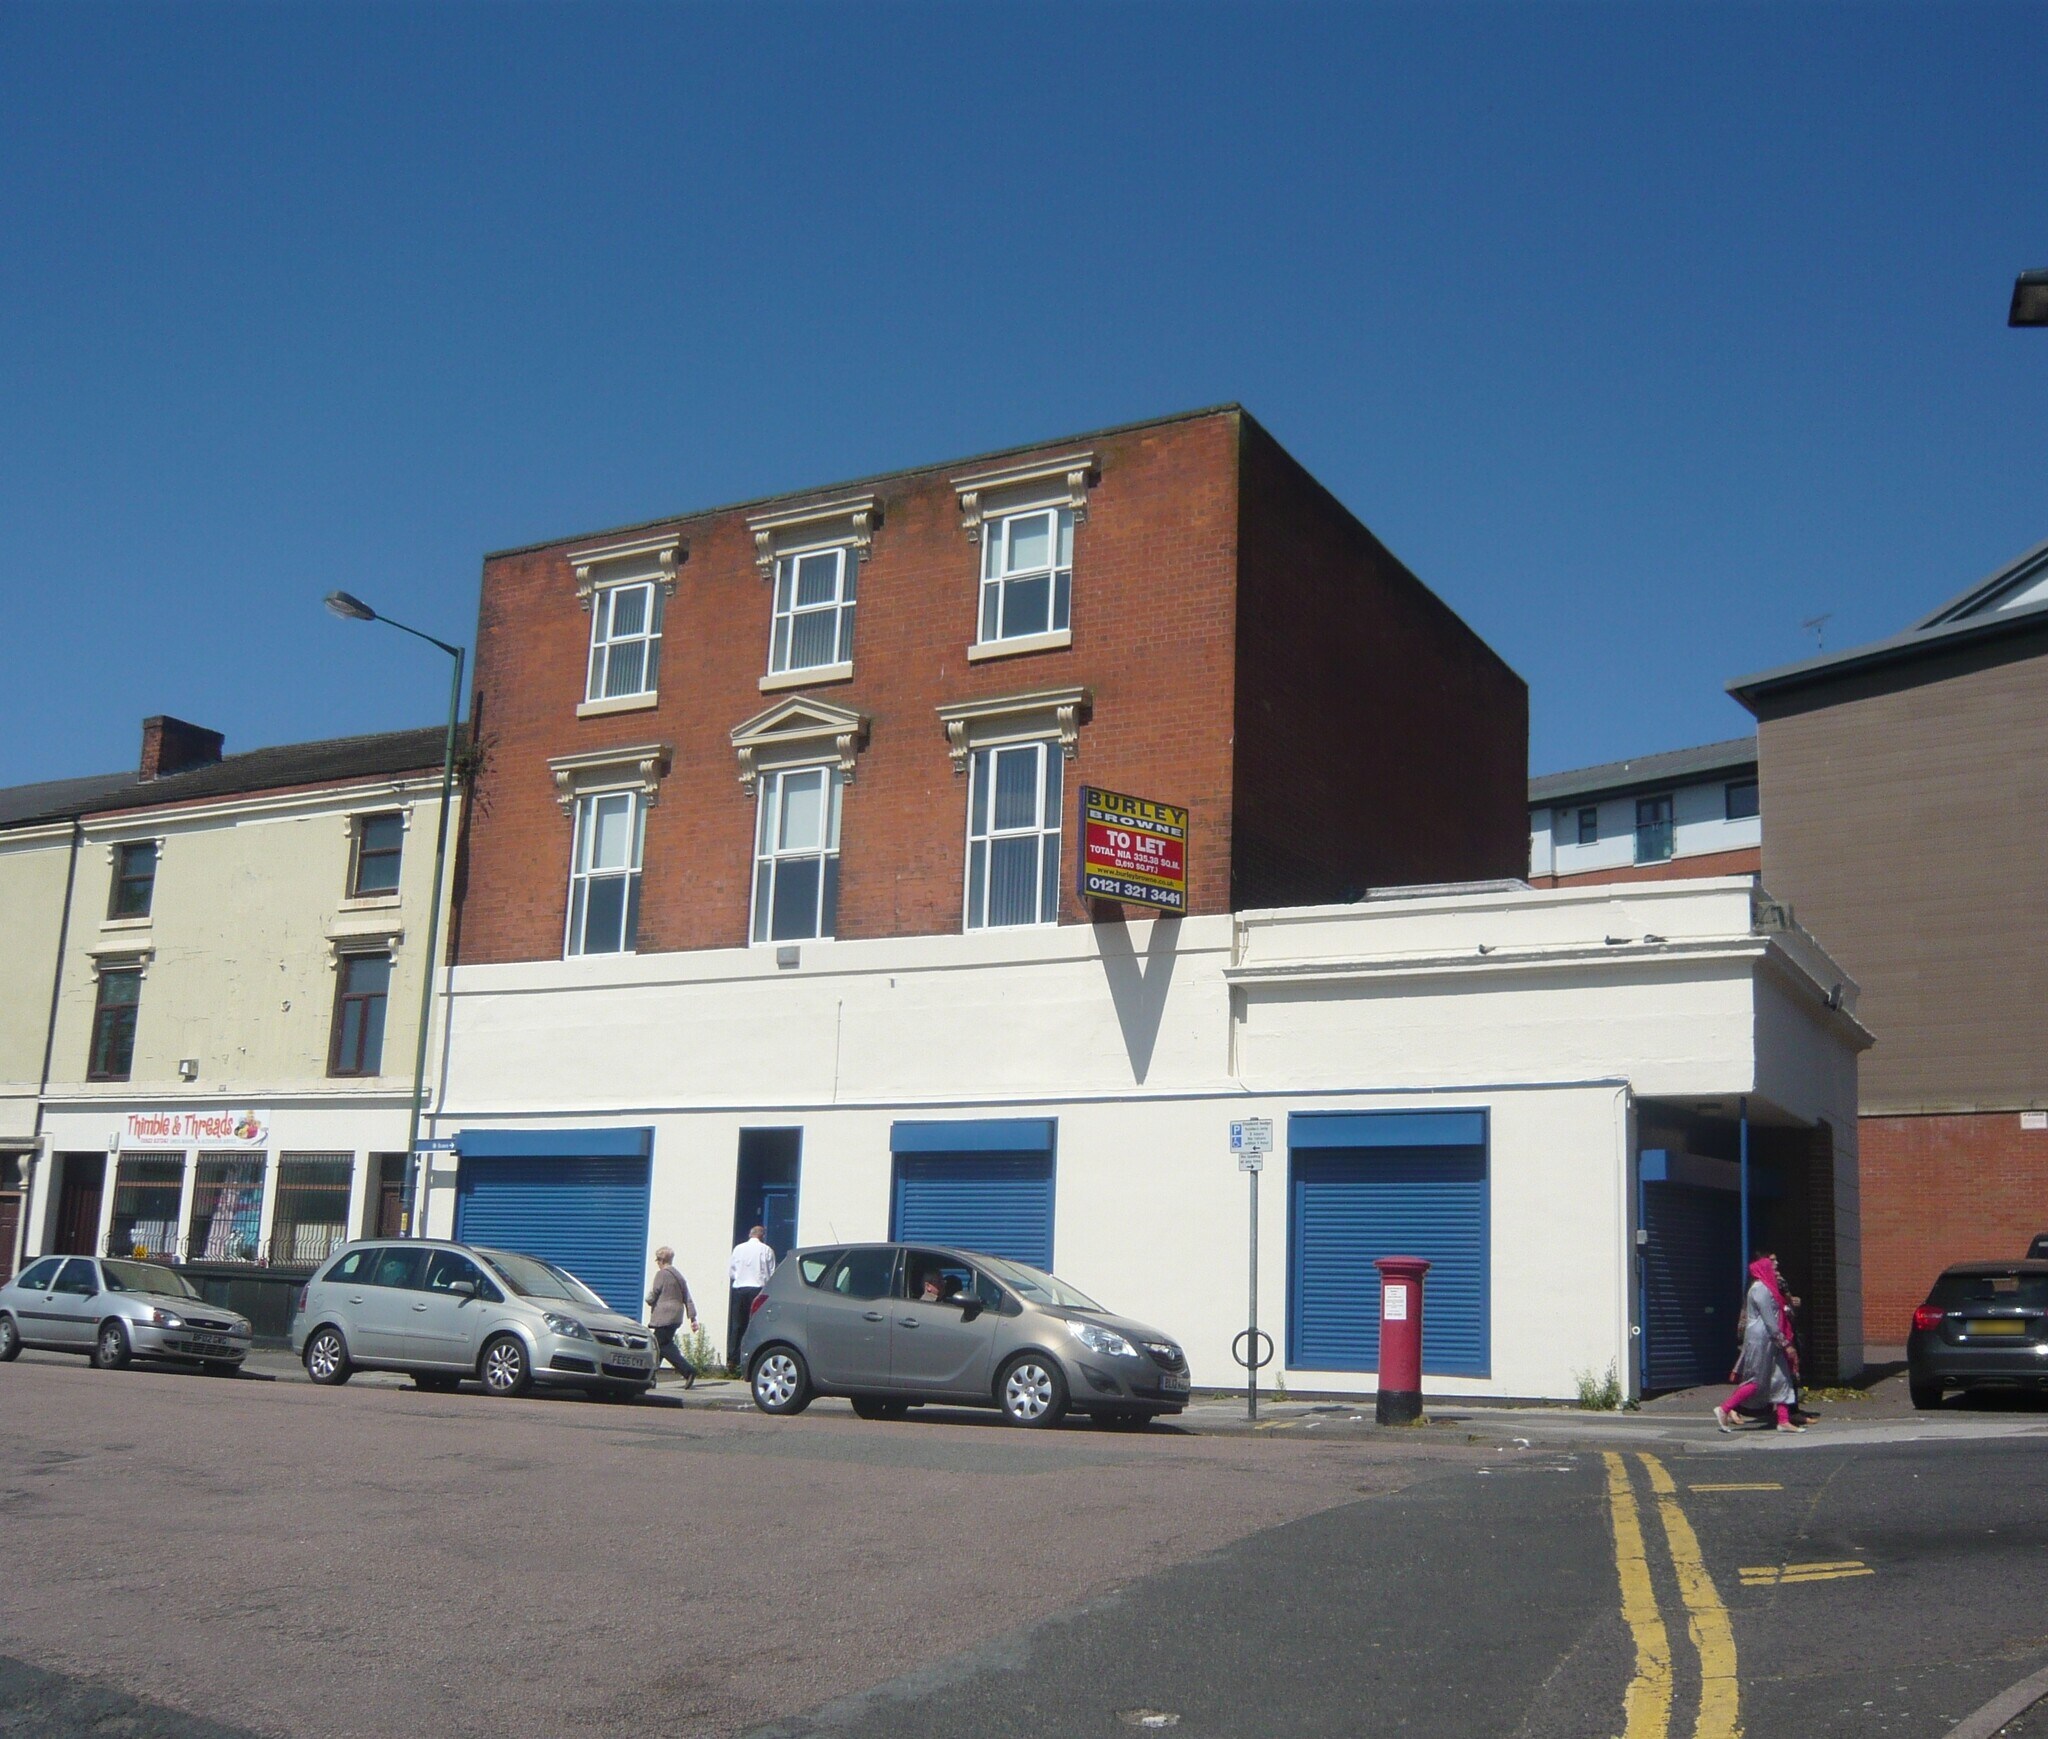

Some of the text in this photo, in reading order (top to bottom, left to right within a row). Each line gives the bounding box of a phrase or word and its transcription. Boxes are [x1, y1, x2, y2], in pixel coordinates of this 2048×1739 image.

[1088, 790, 1185, 825] BURLEY
[1089, 810, 1182, 837] BROWNE
[1090, 845, 1115, 857] TOTAL
[1117, 849, 1131, 860] NIA
[1106, 830, 1166, 856] TO LET
[1097, 867, 1175, 888] www.burleybrowne.co.uk
[1089, 877, 1181, 906] 0121 321 3441
[127, 1110, 234, 1140] Thimble & Threads
